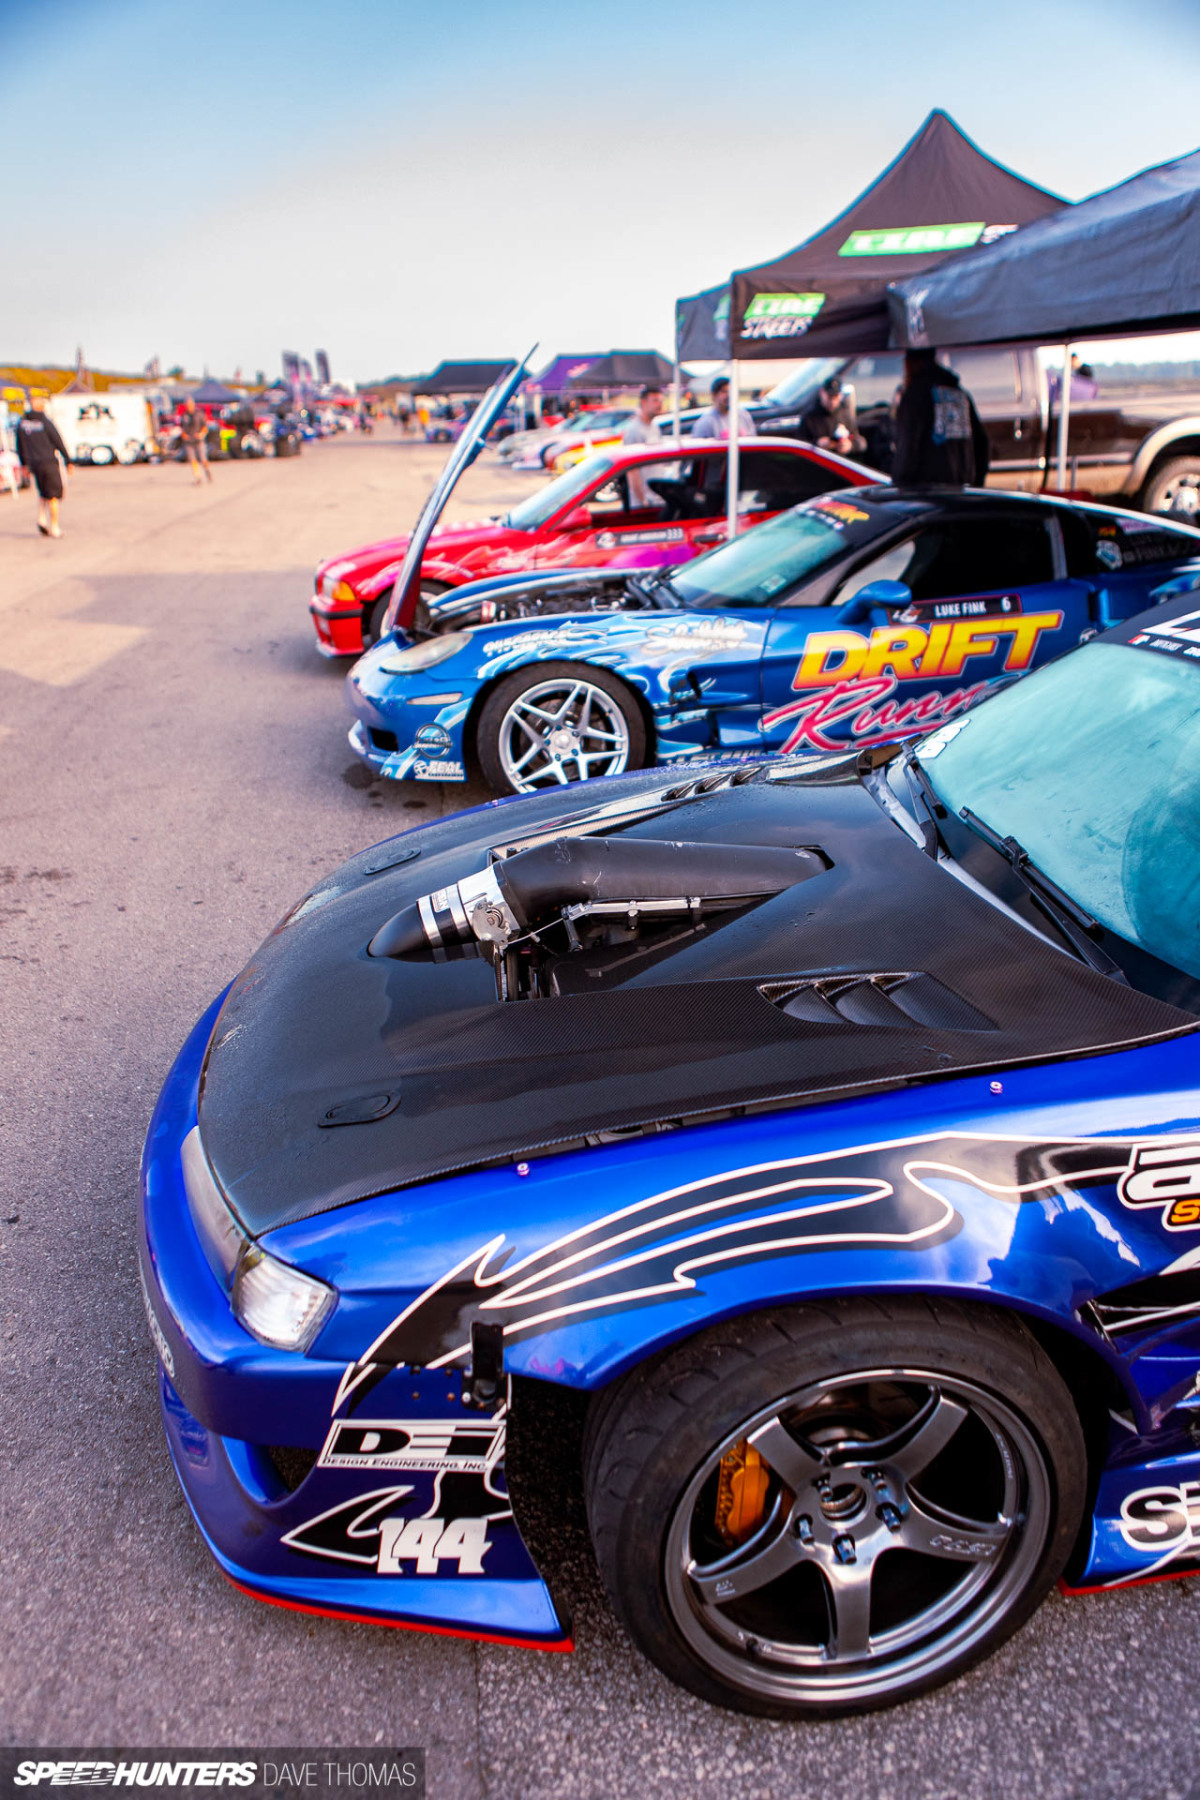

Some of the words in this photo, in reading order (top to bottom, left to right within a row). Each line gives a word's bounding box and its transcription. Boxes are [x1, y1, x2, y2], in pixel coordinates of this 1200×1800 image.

[934, 603, 961, 618] LUKE
[962, 601, 987, 615] FINK
[1001, 596, 1012, 612] 6
[791, 610, 1064, 692] DRIFT
[329, 1425, 499, 1457] DEI
[322, 1456, 369, 1467] DESIGN
[463, 1460, 489, 1472] INC.
[376, 1517, 493, 1574] 144
